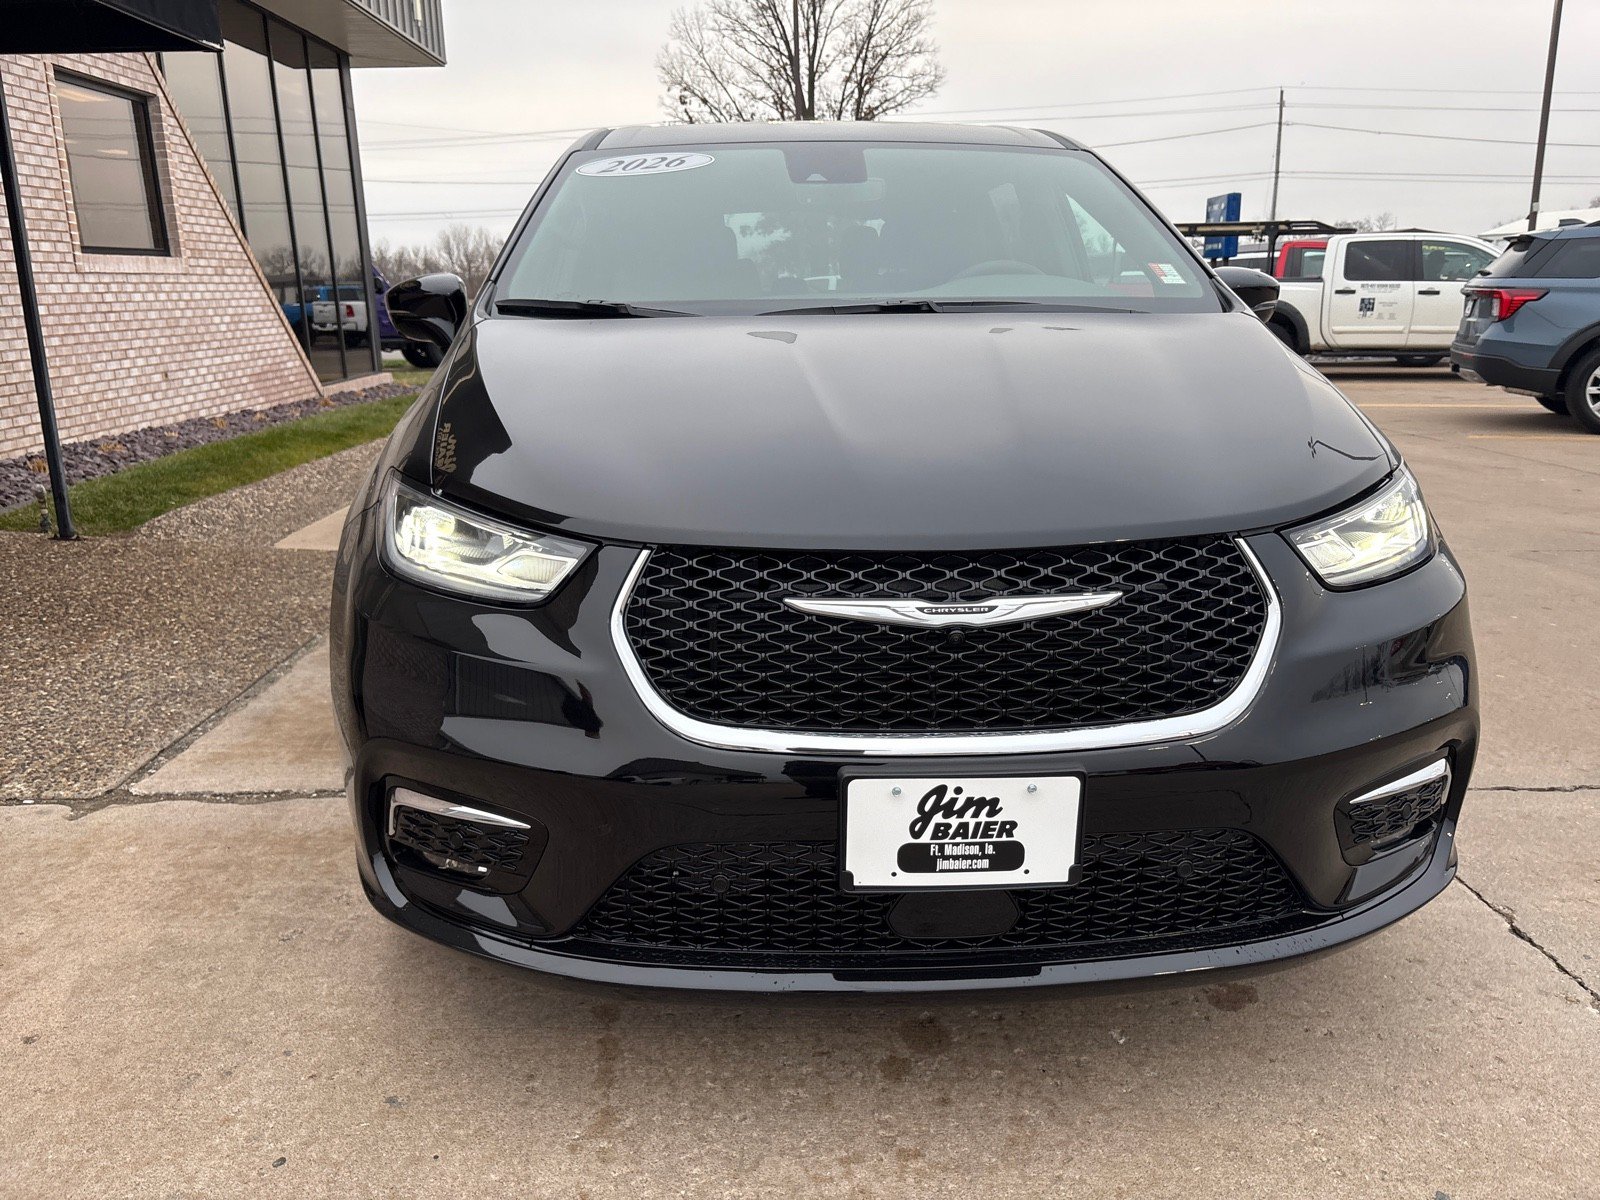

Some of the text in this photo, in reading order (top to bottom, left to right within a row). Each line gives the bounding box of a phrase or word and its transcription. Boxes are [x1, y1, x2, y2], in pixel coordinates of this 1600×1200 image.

[597, 155, 693, 173] 2026
[909, 784, 1003, 840] Jim
[930, 820, 1018, 841] BAIER
[930, 844, 941, 856] Ft.
[944, 843, 982, 856] Madison,
[936, 858, 989, 871] jimbaier.com
